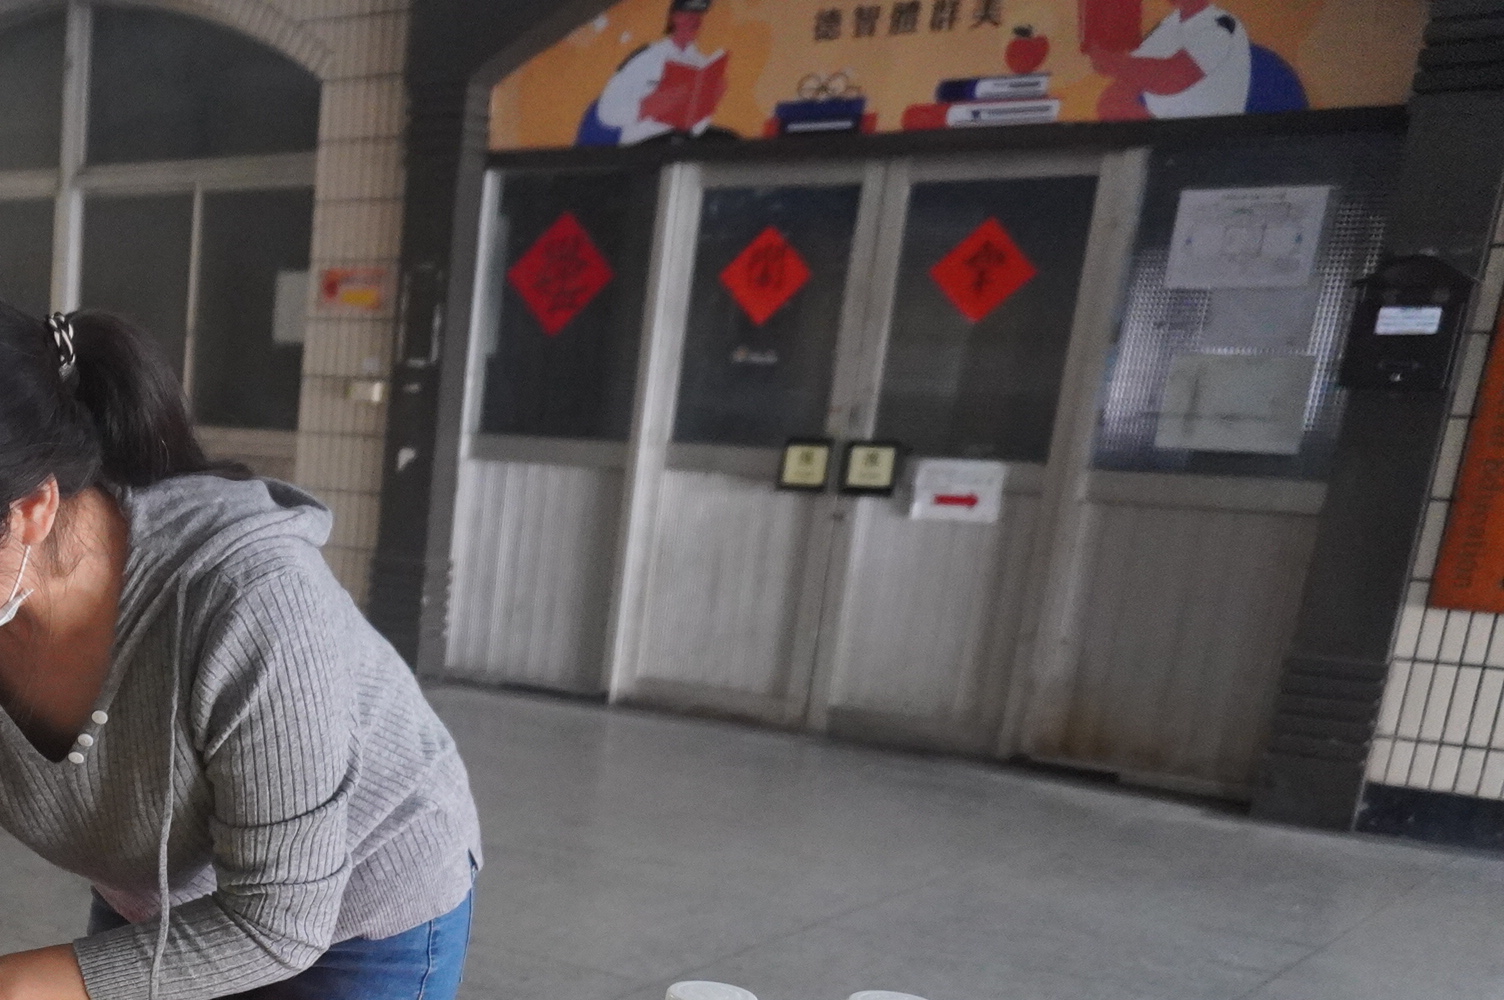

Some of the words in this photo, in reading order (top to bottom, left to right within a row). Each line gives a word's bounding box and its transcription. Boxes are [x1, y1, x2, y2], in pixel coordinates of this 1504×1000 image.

[814, 0, 1001, 41] 德智體群美
